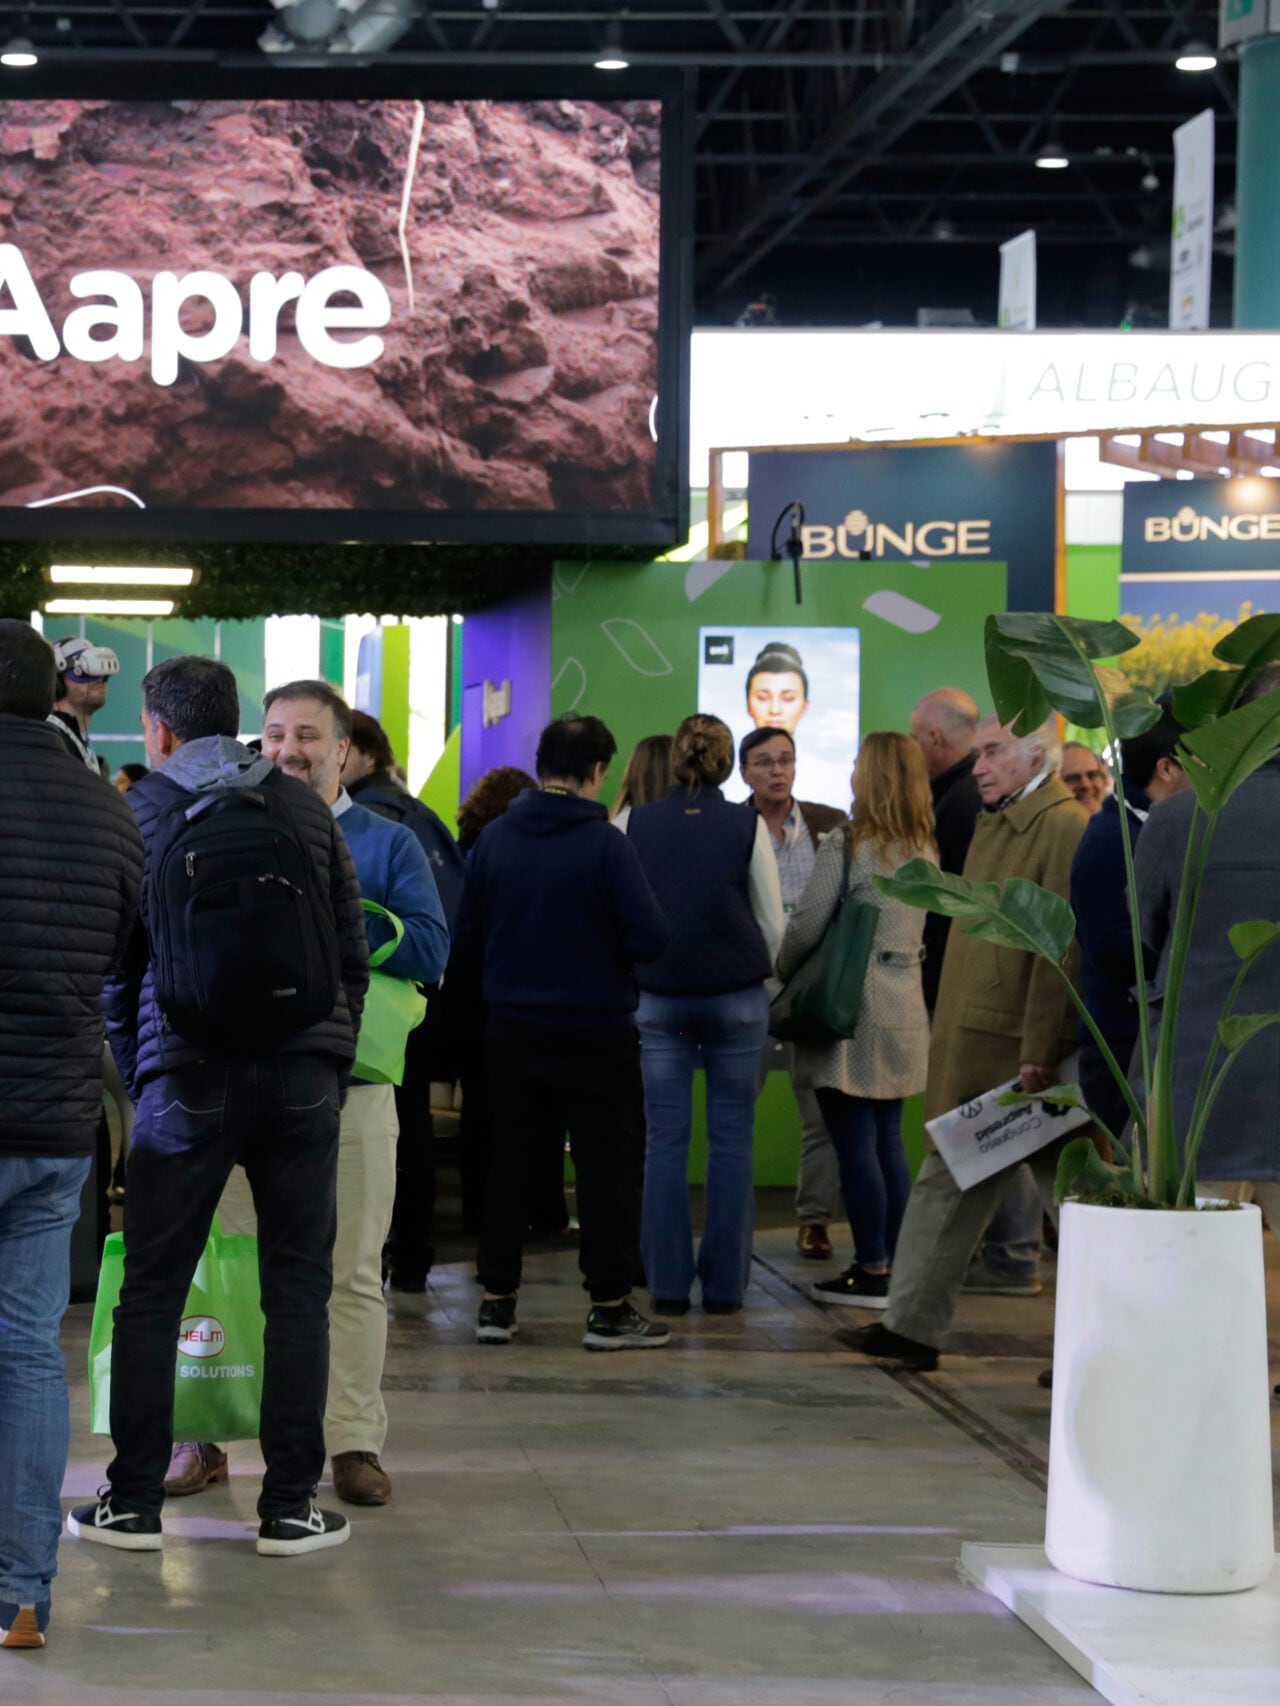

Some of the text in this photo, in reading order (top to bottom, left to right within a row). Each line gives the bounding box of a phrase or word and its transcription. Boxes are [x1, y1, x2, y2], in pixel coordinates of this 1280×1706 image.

[1028, 361, 1271, 402] ALBAUG
[800, 509, 991, 559] BUNGE
[1144, 505, 1280, 542] BUNGE
[979, 1116, 1041, 1153] Congreso
[180, 1364, 255, 1378] SOLUTIONS
